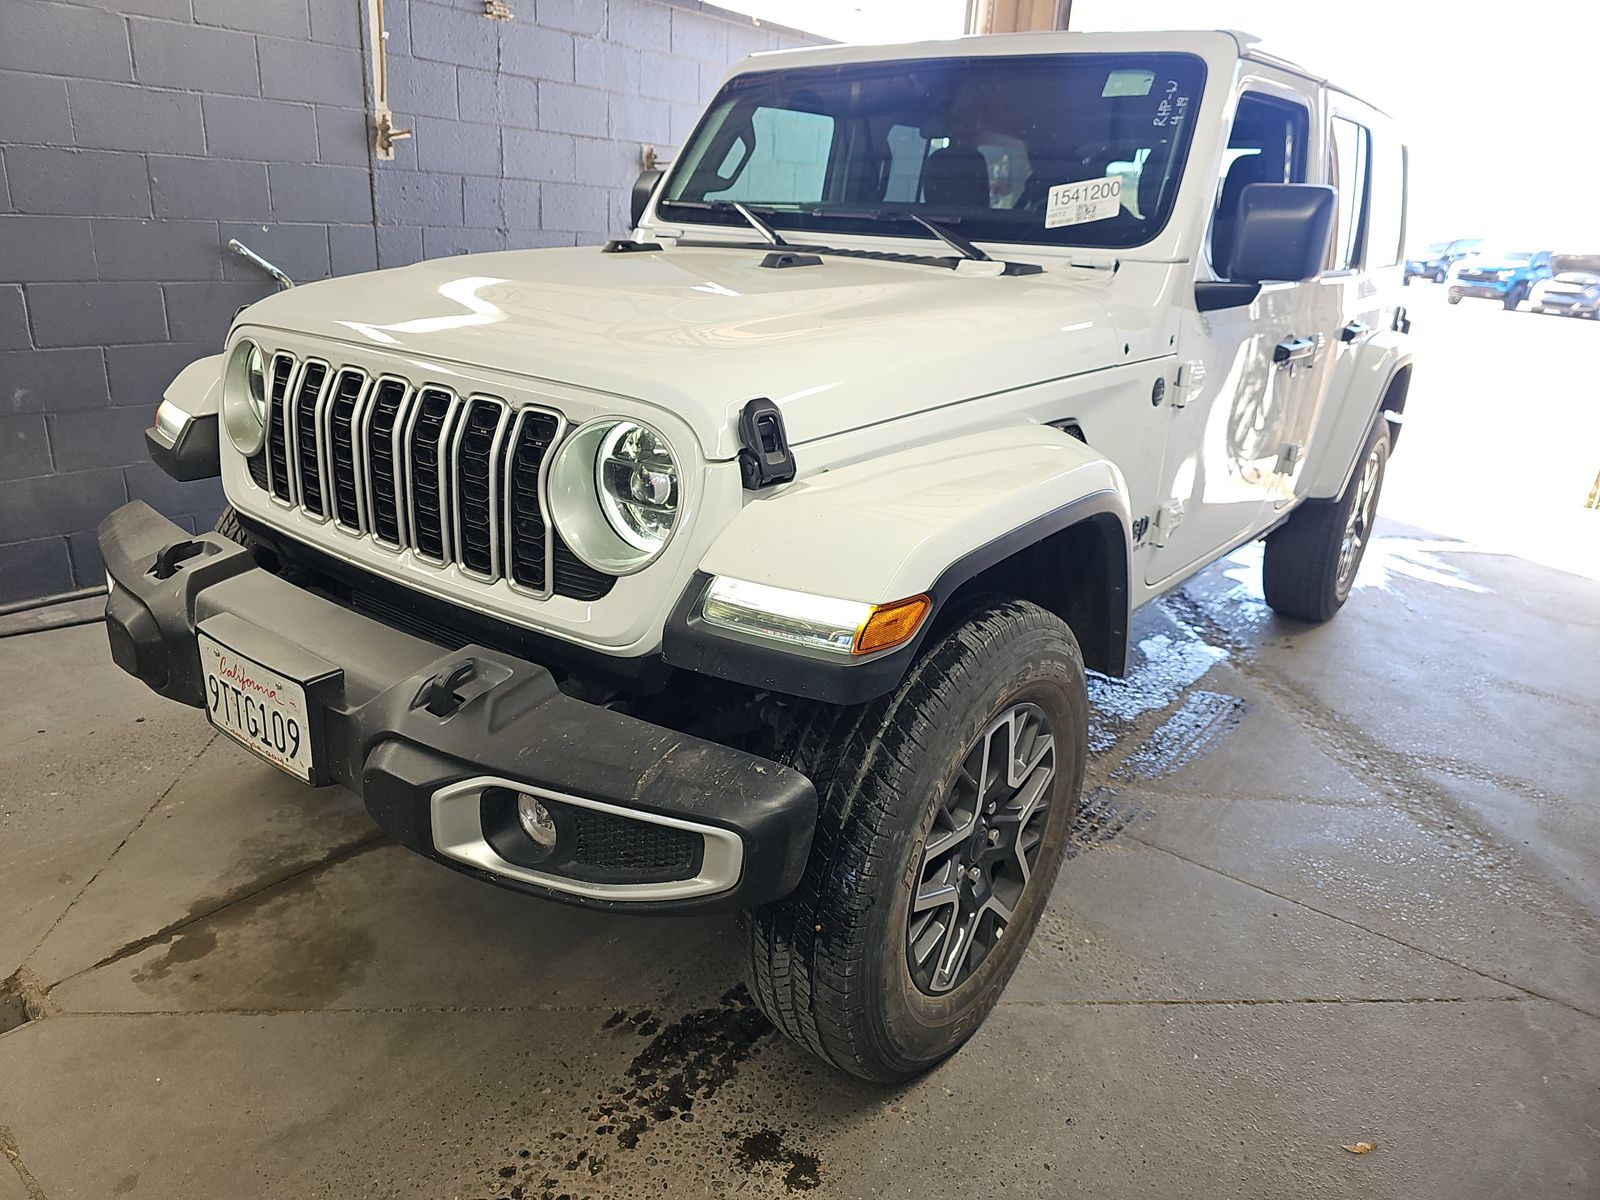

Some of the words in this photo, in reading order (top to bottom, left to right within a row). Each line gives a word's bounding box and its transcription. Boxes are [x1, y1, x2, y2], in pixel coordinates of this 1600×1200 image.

[1053, 181, 1120, 206] 1541200
[220, 656, 285, 706] California
[209, 674, 300, 759] 9TTG109
